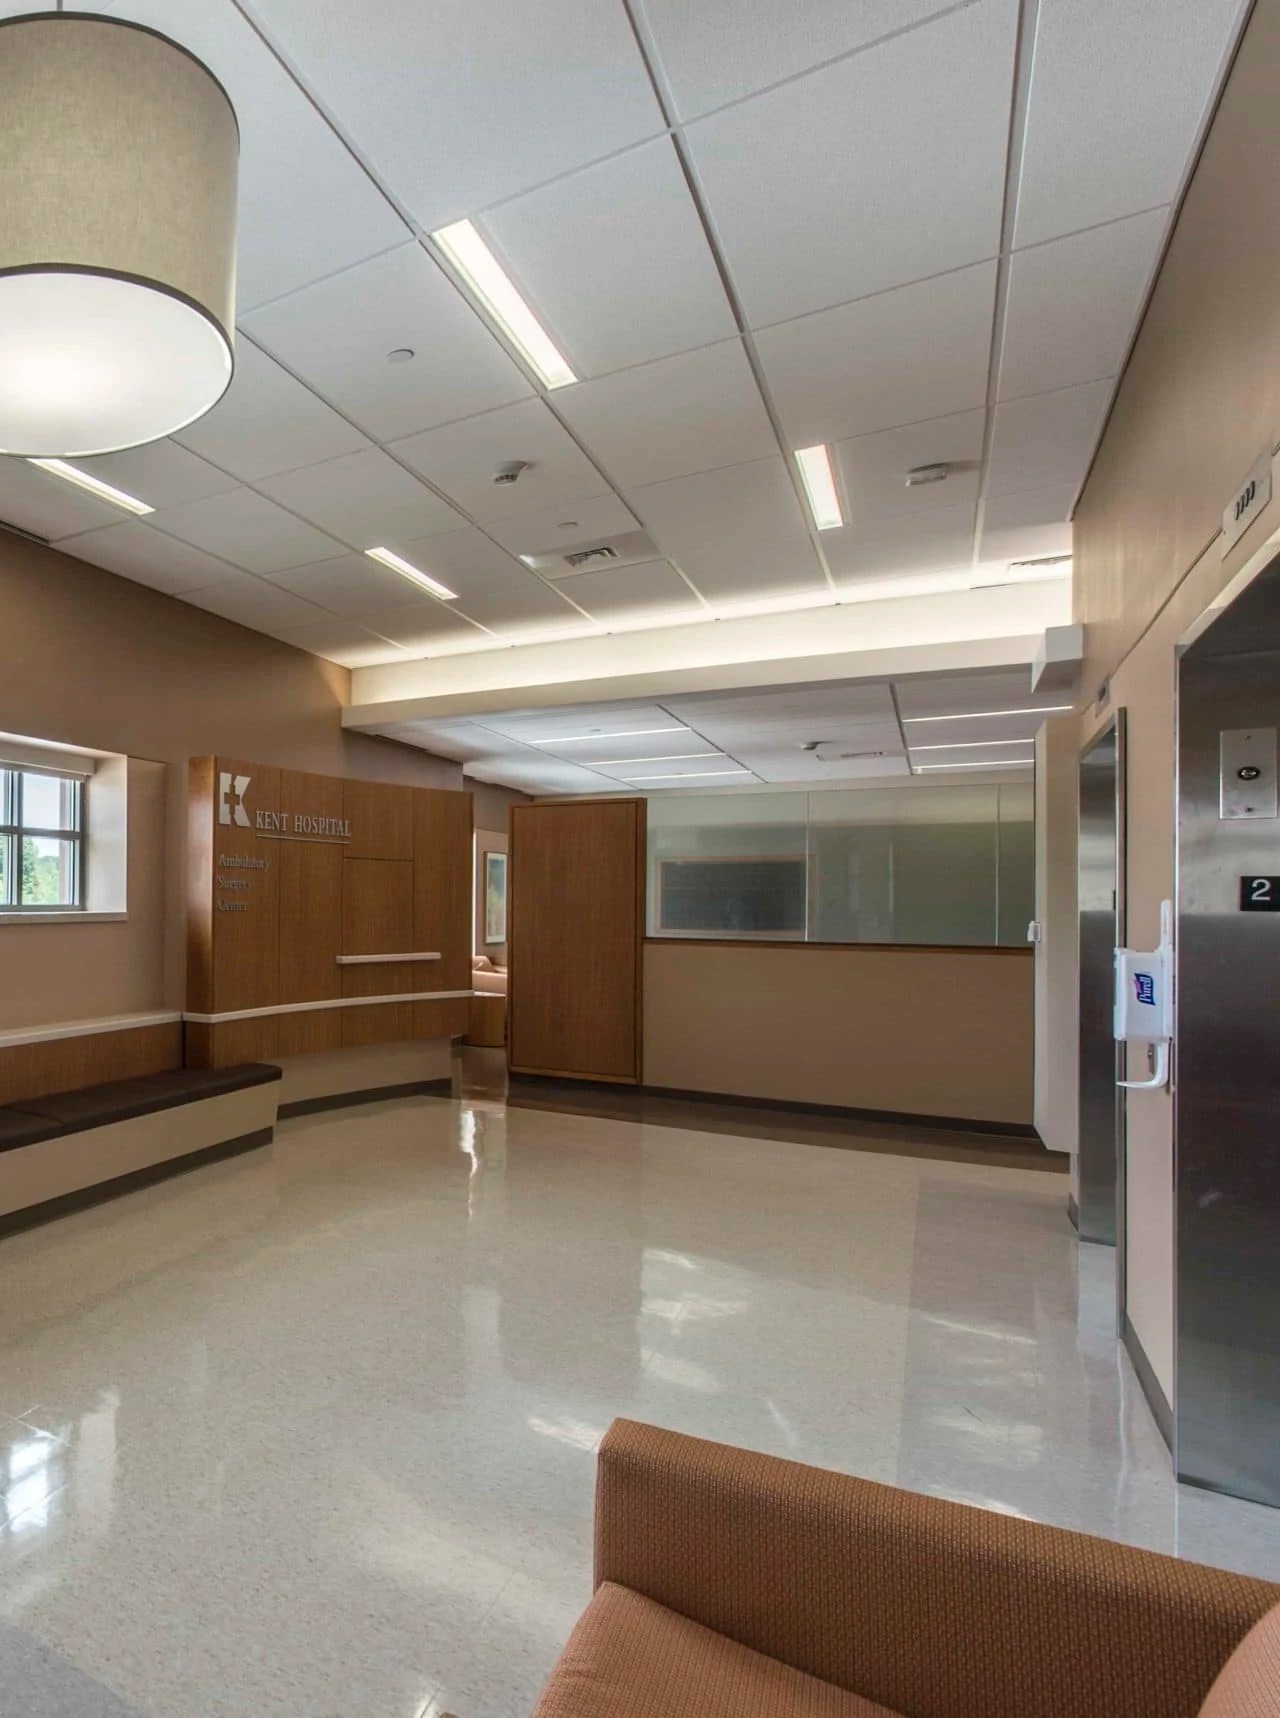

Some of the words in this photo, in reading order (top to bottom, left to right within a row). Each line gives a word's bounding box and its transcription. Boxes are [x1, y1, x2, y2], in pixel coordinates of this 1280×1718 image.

[256, 810, 288, 833] KENT
[294, 815, 351, 837] HOSPITAL
[1252, 879, 1271, 900] 2
